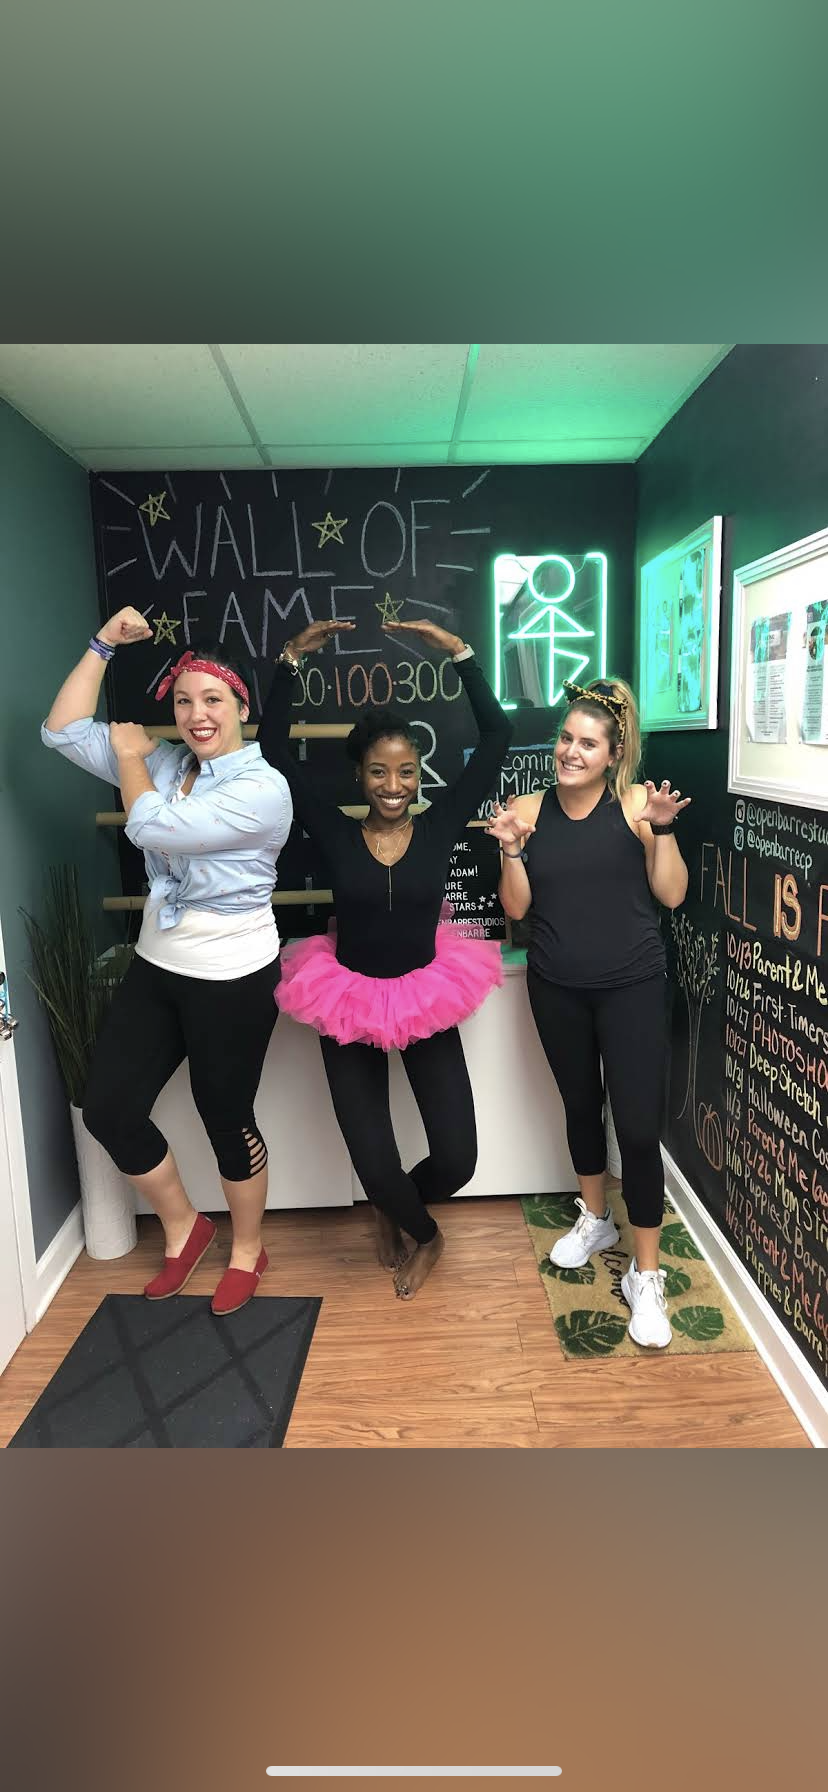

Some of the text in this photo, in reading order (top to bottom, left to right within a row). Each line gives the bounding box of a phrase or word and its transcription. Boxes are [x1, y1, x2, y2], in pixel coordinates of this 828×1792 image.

[137, 499, 450, 580] WALL OF
[183, 585, 382, 657] FAME
[449, 902, 477, 911] STARS
[700, 842, 757, 932] FALL
[773, 873, 802, 941] IS
[726, 964, 750, 1000] 10/26
[727, 931, 828, 1006] 10/13 Parent & Me
[726, 995, 828, 1093] 10/27 PHOTOSHO
[726, 1023, 823, 1126] 10/27 Deep Stretch
[726, 1053, 744, 1093] 10/31
[748, 1075, 810, 1150] Halloween
[726, 1088, 741, 1120] 11/3
[748, 1108, 777, 1157] Parent
[777, 1138, 786, 1171] &
[788, 1148, 808, 1192] Me
[744, 1164, 782, 1230] Puppies
[782, 1209, 792, 1244] &
[745, 1200, 779, 1266] Parent
[781, 1247, 790, 1280] &
[792, 1260, 811, 1317] Me
[746, 1235, 782, 1303] Puppies
[784, 1286, 792, 1316] &
[794, 1299, 823, 1361] Barre
